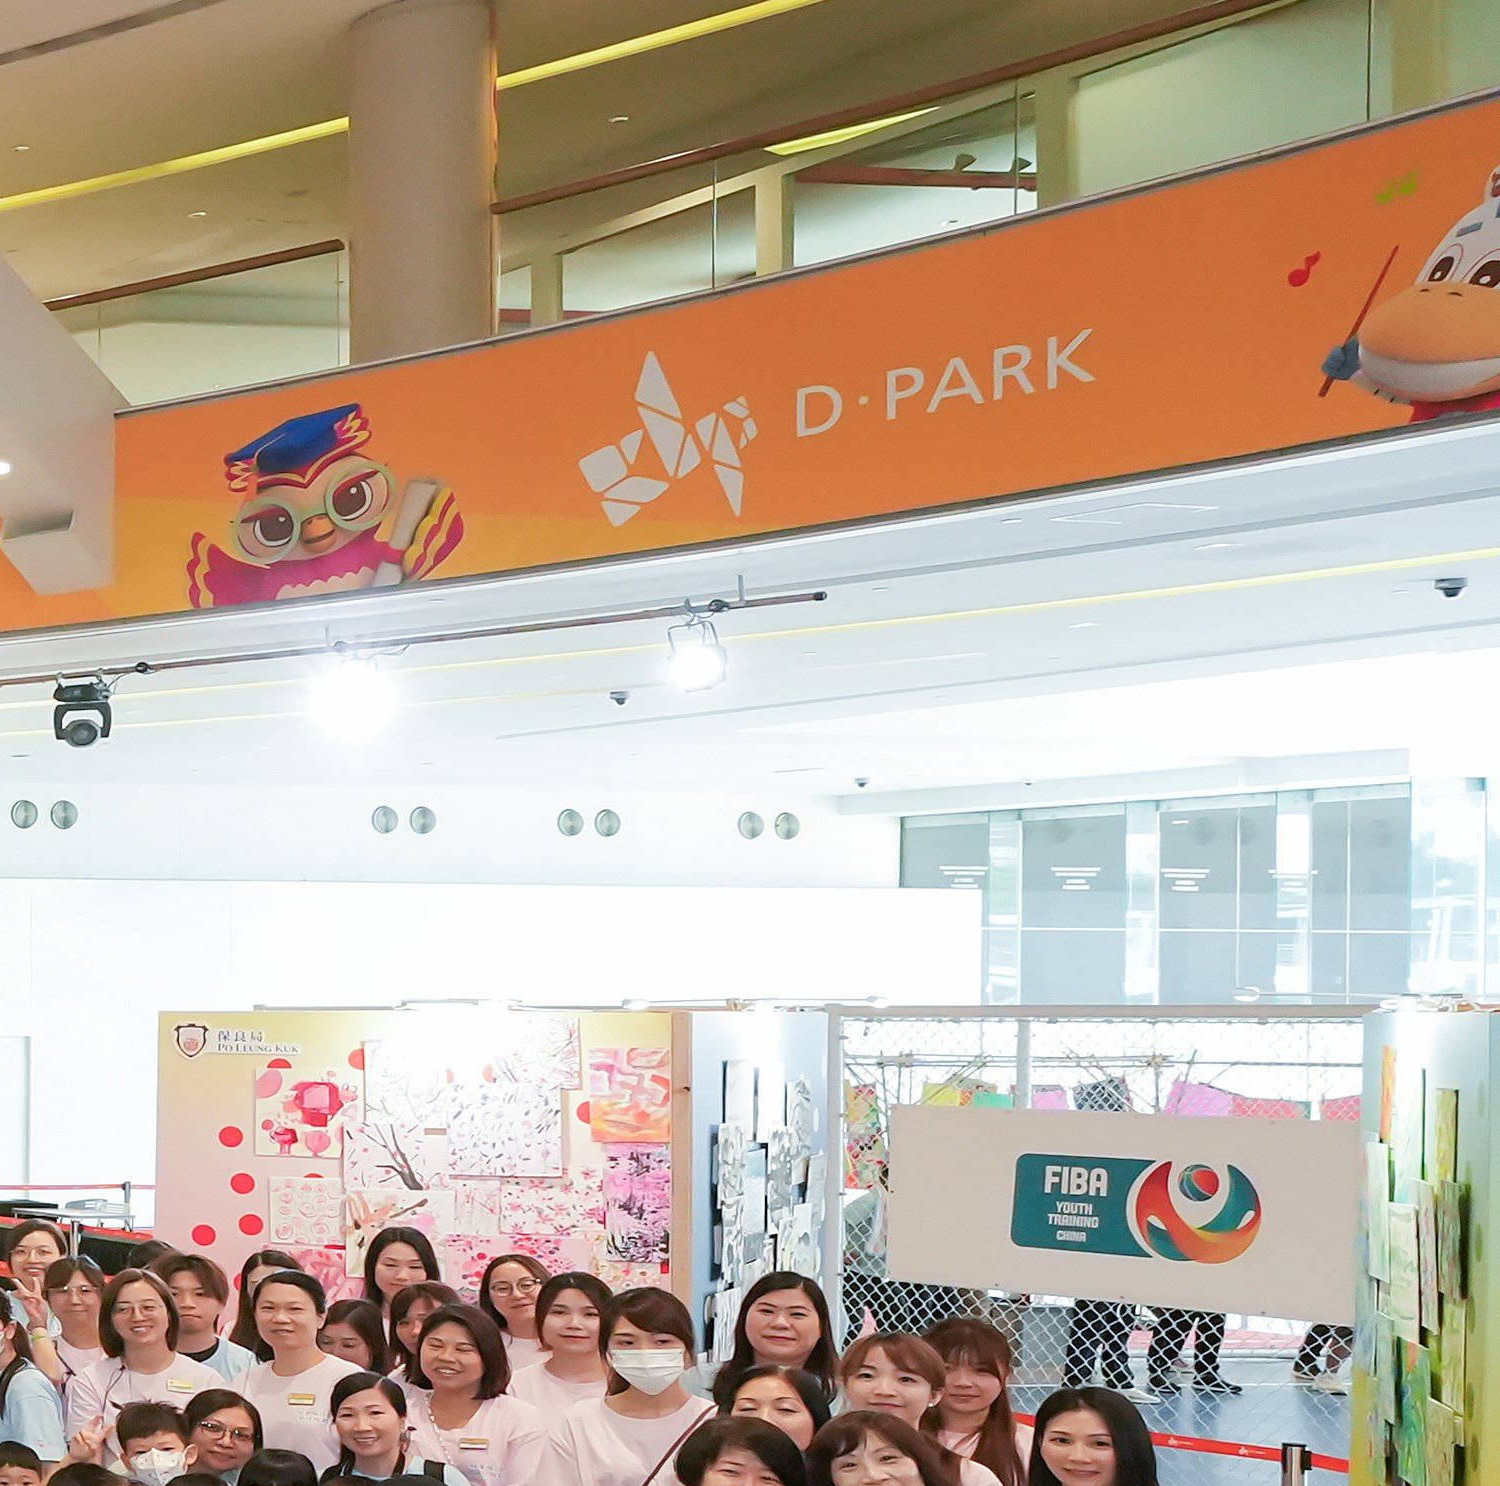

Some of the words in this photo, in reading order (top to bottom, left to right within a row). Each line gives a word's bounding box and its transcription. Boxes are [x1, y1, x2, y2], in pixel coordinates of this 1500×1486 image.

[218, 1030, 263, 1042] 保良局
[218, 1043, 233, 1052] PO
[236, 1044, 272, 1053] LEUNG
[275, 1045, 299, 1053] KUK
[1044, 1165, 1109, 1197] FIBA
[1056, 1201, 1093, 1215] YOUTH
[1047, 1213, 1099, 1229] TRAINING
[1056, 1230, 1086, 1243] CHINA
